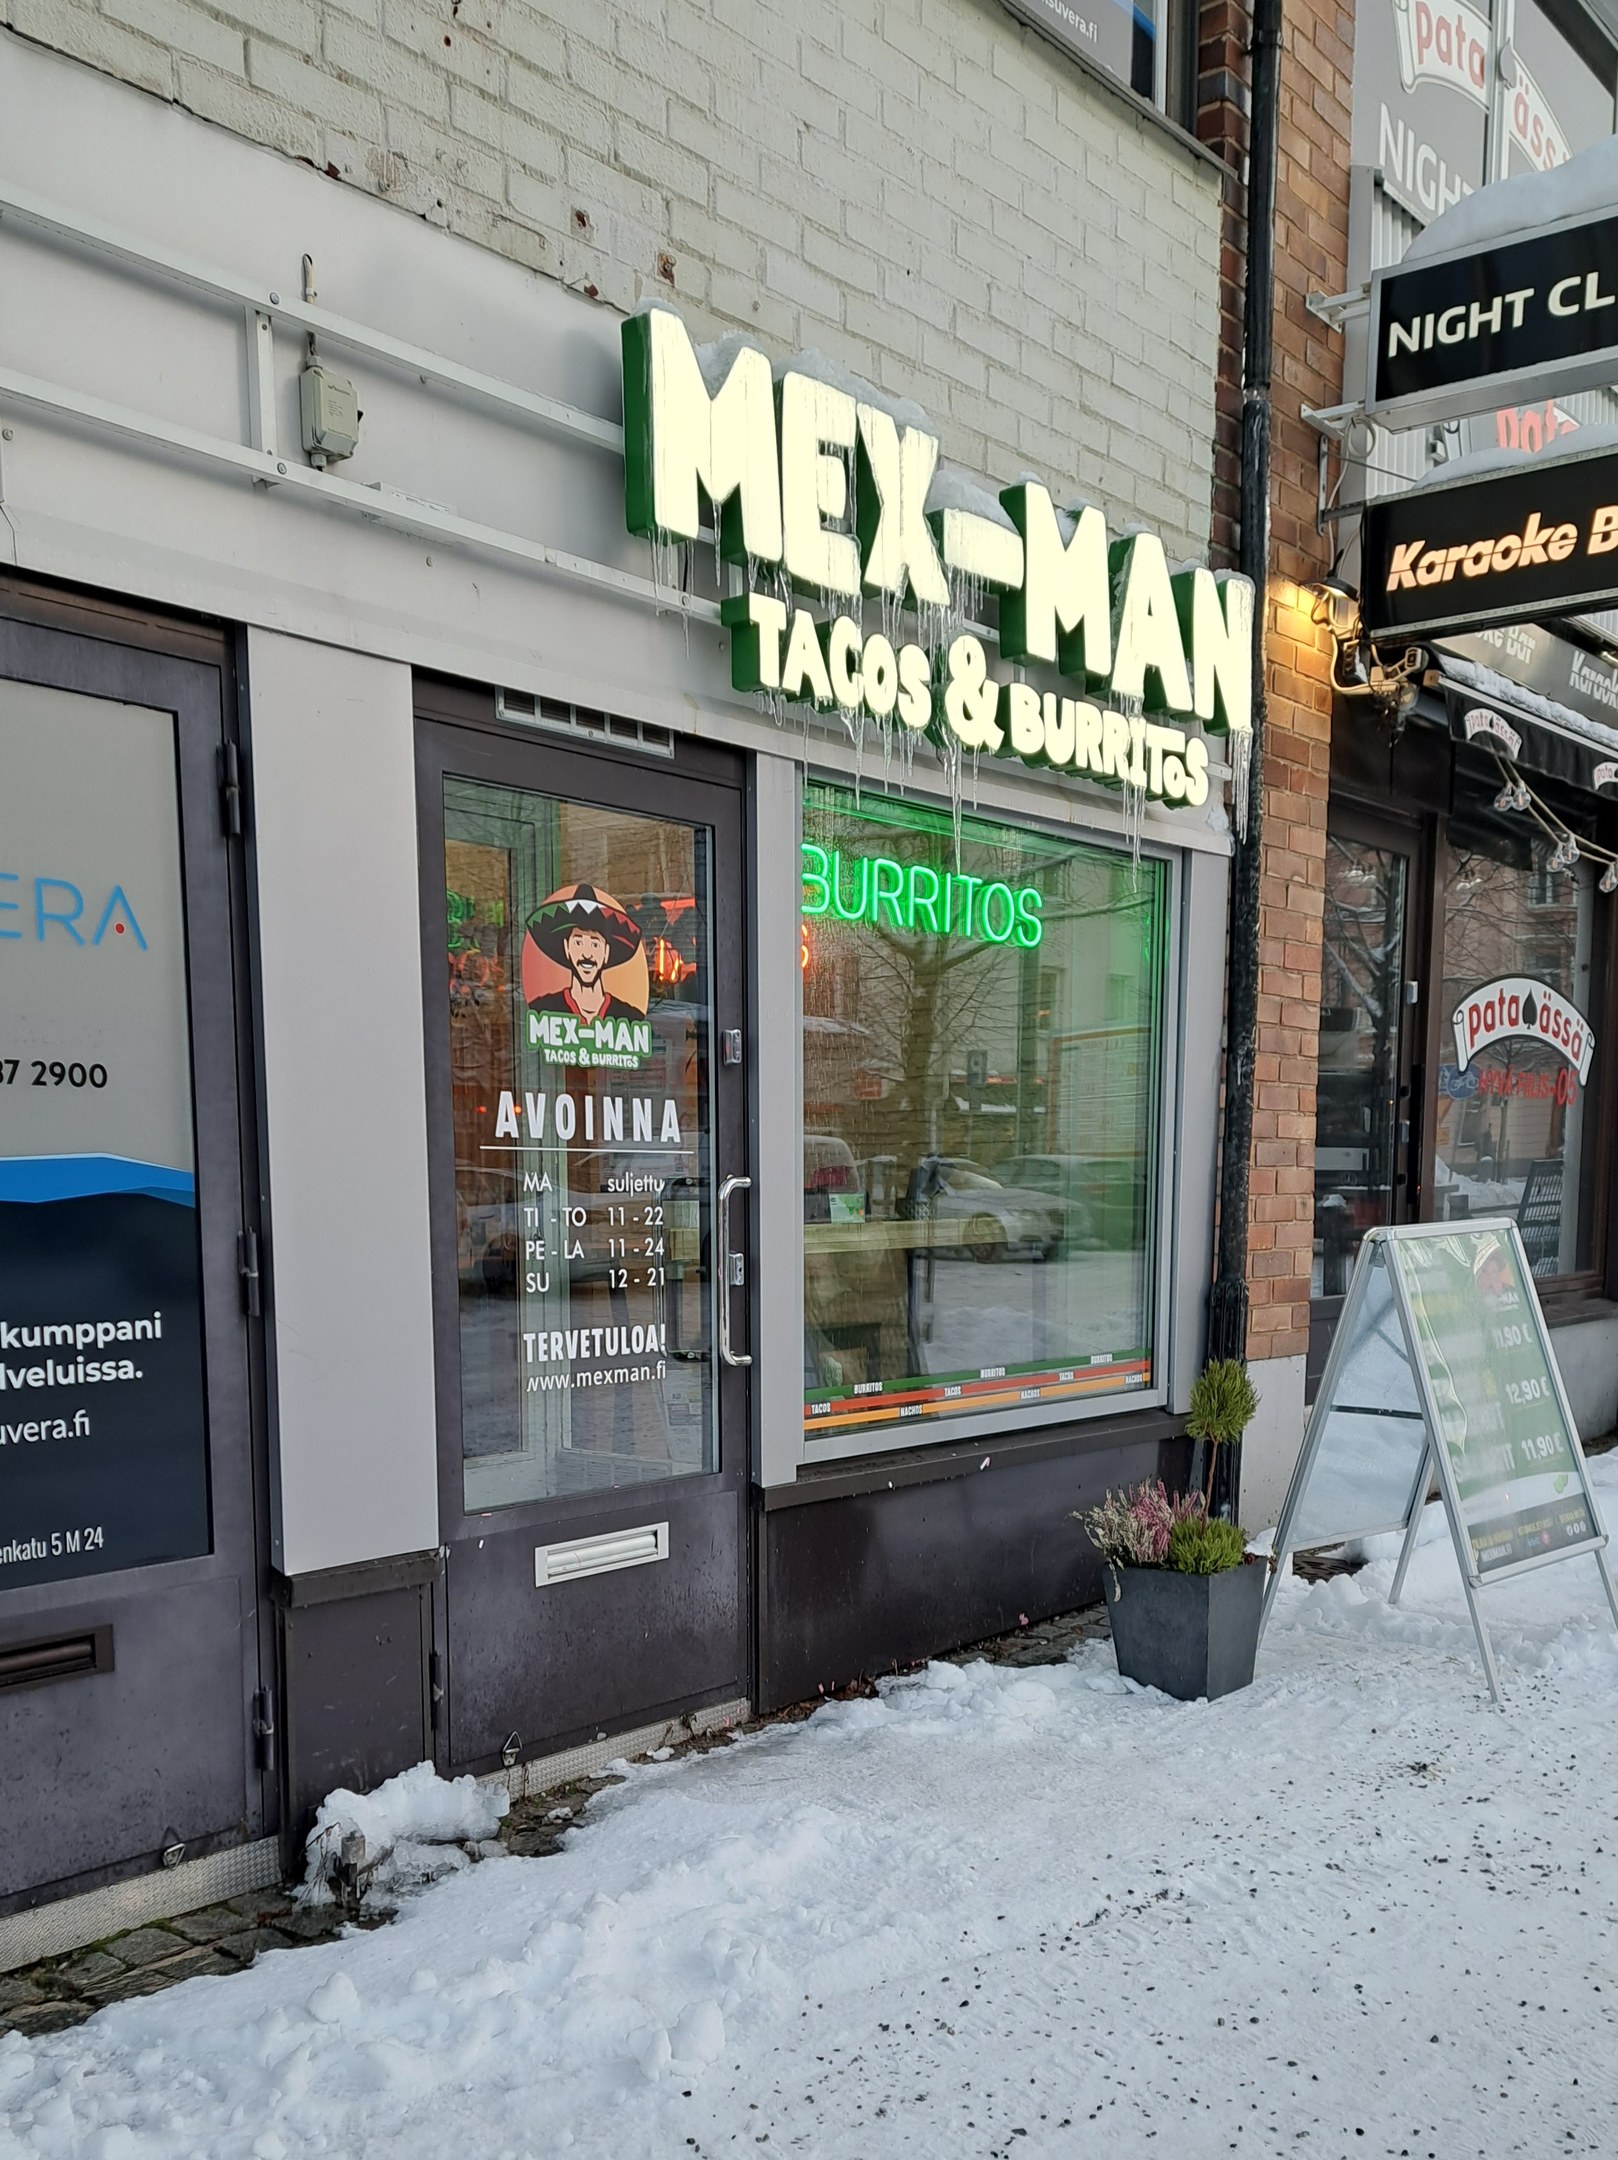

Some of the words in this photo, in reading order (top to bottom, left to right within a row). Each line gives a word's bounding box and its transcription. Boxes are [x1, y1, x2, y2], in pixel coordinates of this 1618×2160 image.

[1415, 1, 1484, 89] pata
[1379, 102, 1475, 216] NIGH
[1388, 288, 1535, 358] NIGHT
[1548, 271, 1616, 316] CL
[649, 307, 1255, 736] MEX-MAN
[1386, 512, 1578, 592] Karaoke
[748, 591, 932, 730] TACOS
[945, 635, 1005, 746] &
[1009, 683, 1209, 806] BURRITOS
[801, 843, 1043, 948] BURRITOS
[529, 1014, 649, 1053] MEX-MAN
[1468, 988, 1520, 1049] pata
[1539, 990, 1584, 1061] ässä
[544, 1048, 576, 1064] TACOS
[579, 1047, 591, 1066] &
[592, 1053, 639, 1068] BURRITOS
[31, 1060, 108, 1088] 2900
[495, 1091, 681, 1143] AVOINNA
[523, 1172, 553, 1192] MA
[607, 1172, 665, 1197] suljettu
[524, 1207, 539, 1228] TI
[562, 1207, 587, 1227] TO
[608, 1206, 625, 1226] 11
[644, 1206, 664, 1226] 22
[525, 1240, 545, 1261] PE
[564, 1239, 585, 1259] LA
[608, 1238, 625, 1258] 11
[644, 1237, 665, 1257] 24
[526, 1272, 549, 1293] SU
[609, 1268, 628, 1289] 12
[647, 1267, 665, 1286] 21
[0, 1311, 162, 1349] kumppani
[523, 1323, 666, 1363] TERVETULOA!
[527, 1360, 666, 1392] www.mexman.fi
[854, 1381, 883, 1395] BURRITOS
[944, 1385, 962, 1397] TACOS
[1505, 1378, 1541, 1405] 12,90
[811, 1402, 831, 1415] TACOS
[900, 1405, 923, 1417] NACHOS
[1521, 1435, 1555, 1461] 11,90
[51, 1532, 62, 1556] 5
[66, 1529, 80, 1554] M
[84, 1526, 104, 1551] 24
